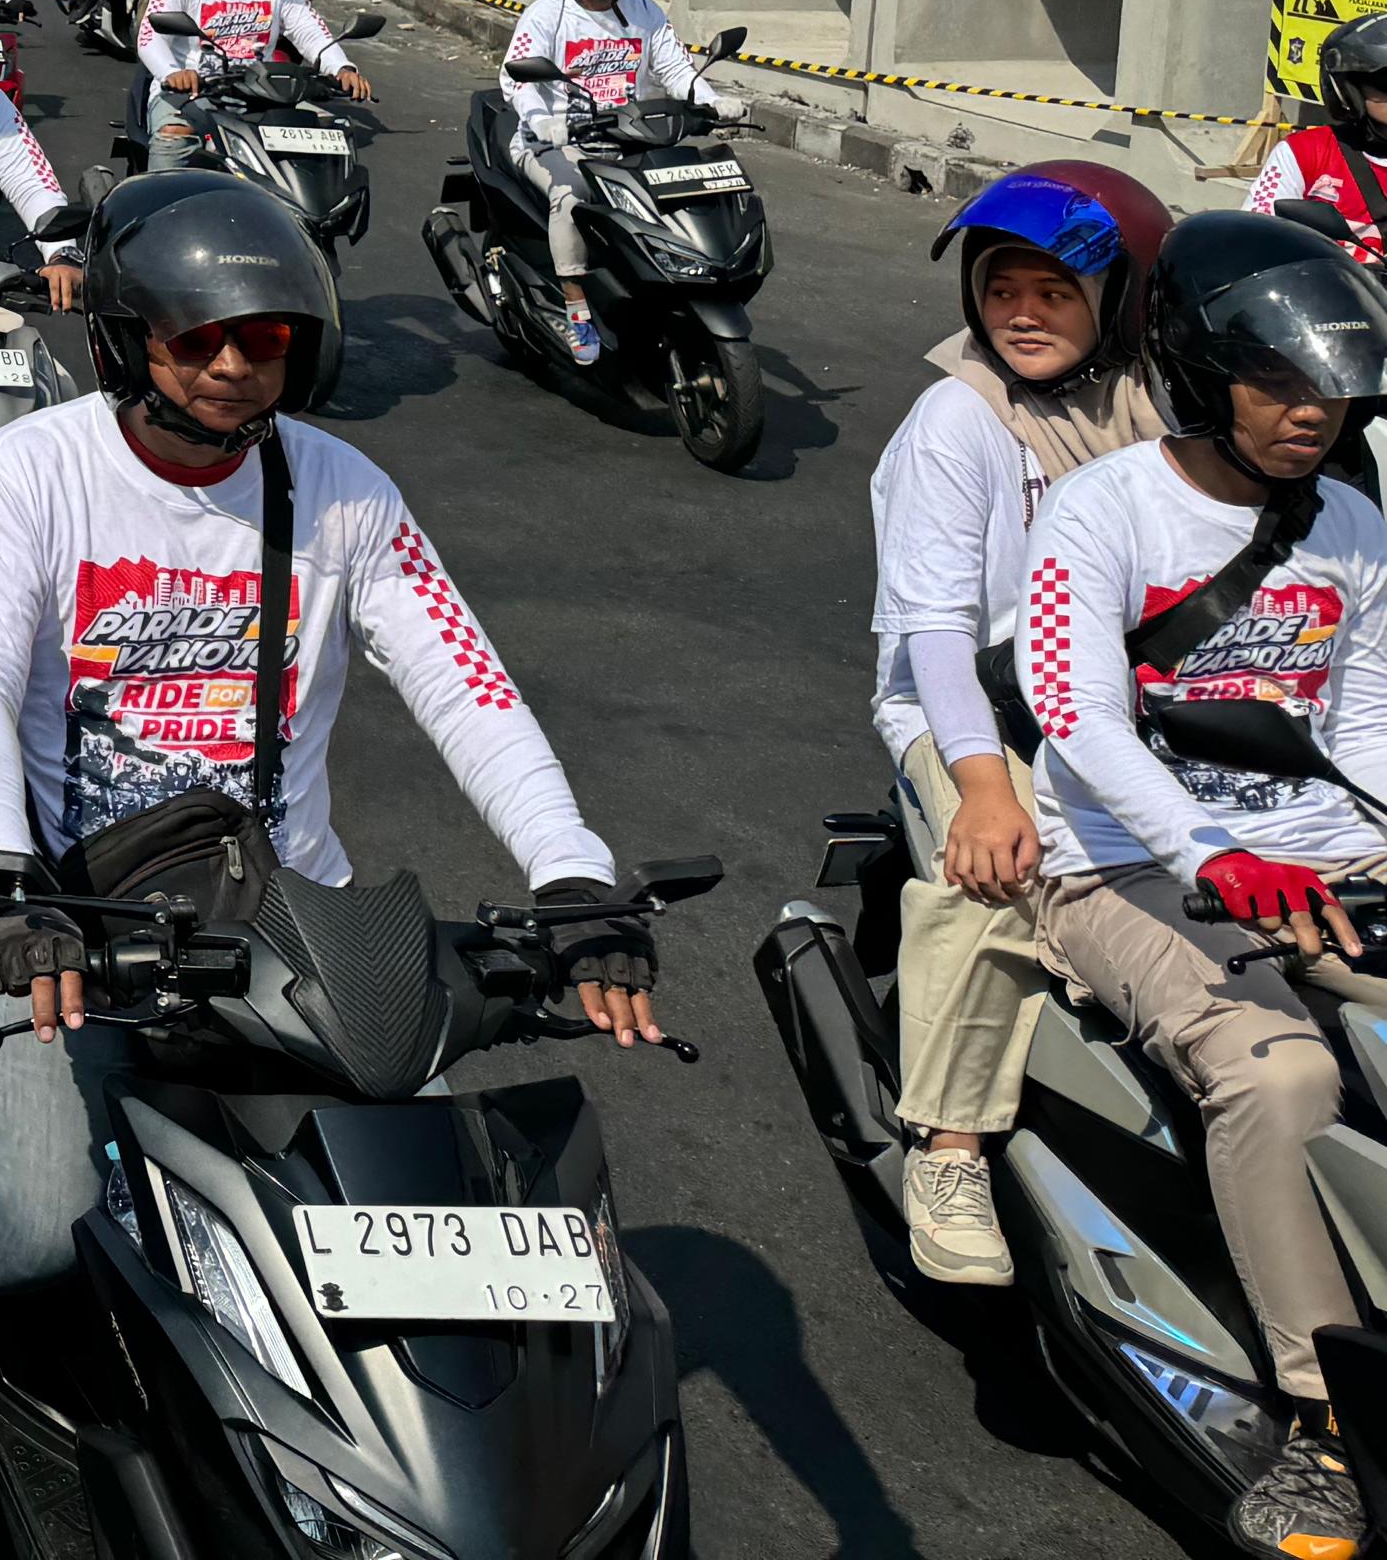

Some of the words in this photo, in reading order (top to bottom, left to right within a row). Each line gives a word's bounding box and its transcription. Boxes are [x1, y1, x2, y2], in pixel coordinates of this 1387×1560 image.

[217, 254, 280, 268] HONDA
[1313, 321, 1371, 332] HONDA
[1, 350, 26, 367] BD
[83, 608, 258, 642] PARADE
[114, 640, 232, 674] VARIO
[1180, 643, 1283, 677] VARIO
[1280, 638, 1334, 671] 160
[120, 683, 204, 711] RIDE
[207, 689, 243, 703] FOR
[1185, 679, 1256, 702] RIDE
[138, 719, 238, 742] PRIDE
[303, 1209, 333, 1255] L
[353, 1211, 472, 1258] 2973
[499, 1211, 593, 1258] DAB
